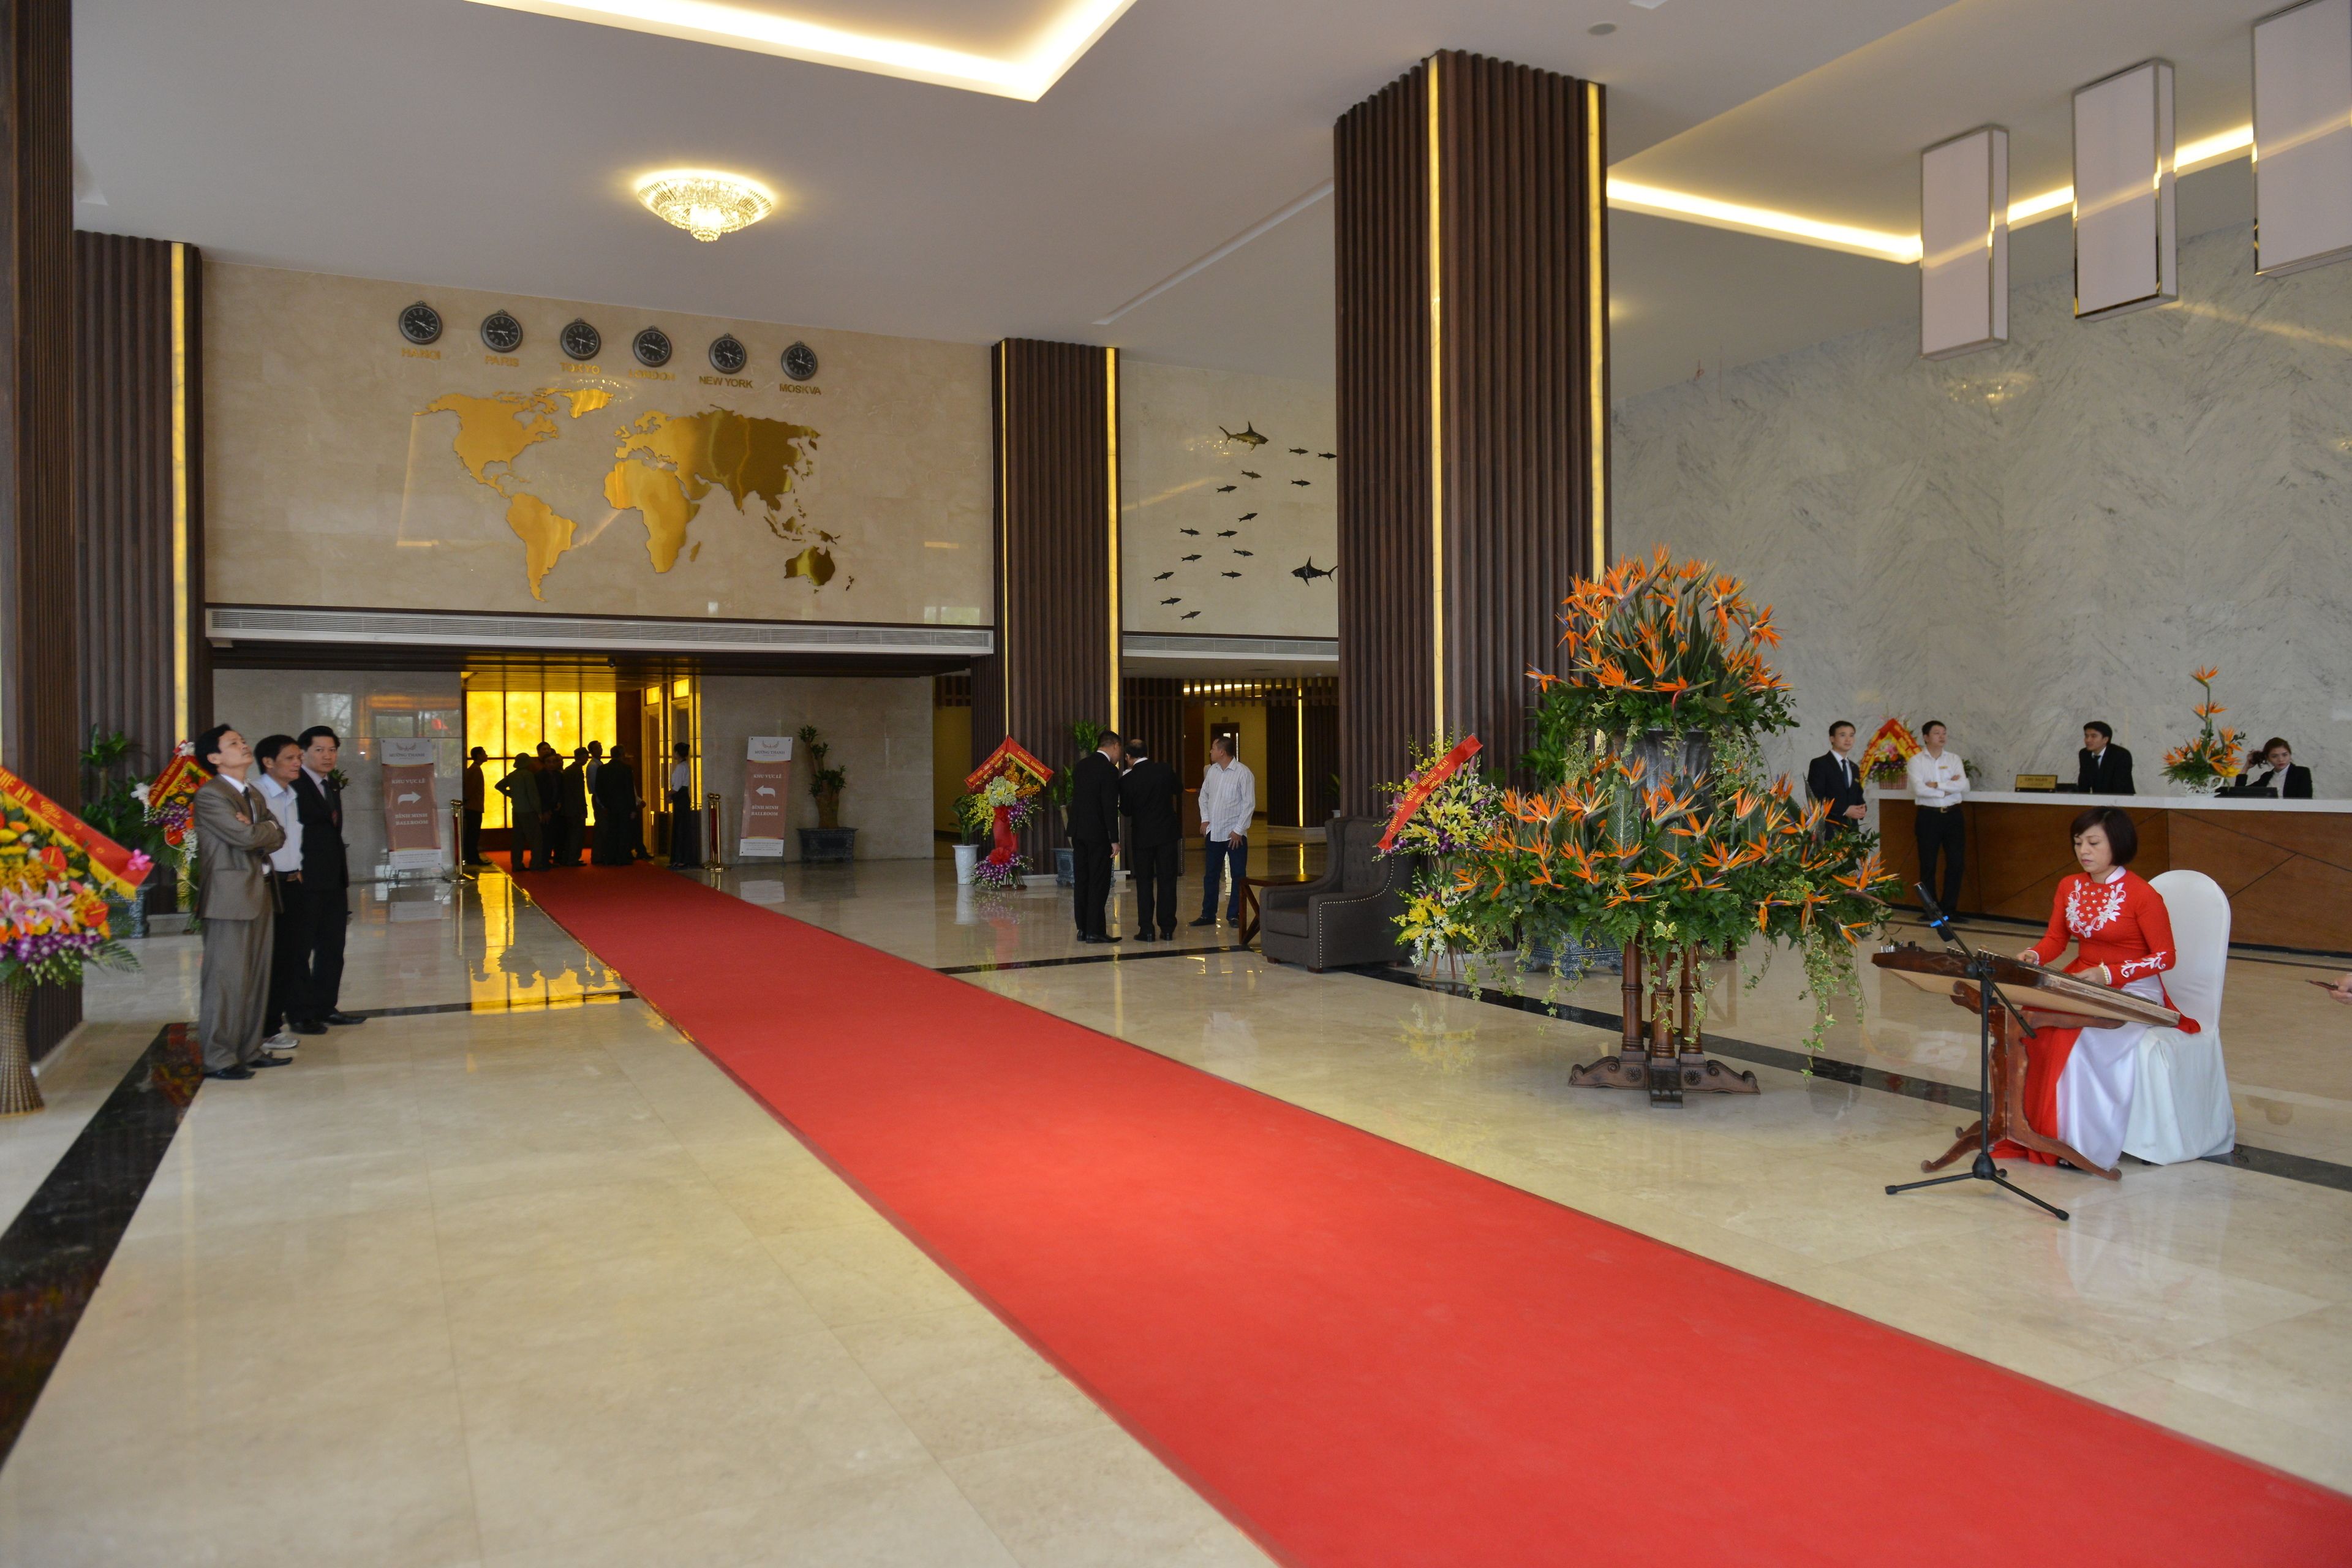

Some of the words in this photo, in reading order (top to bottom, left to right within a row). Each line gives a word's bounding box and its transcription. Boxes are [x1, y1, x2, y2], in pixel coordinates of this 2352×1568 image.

[401, 348, 441, 360] HANOI
[484, 355, 520, 368] PARIS
[560, 362, 601, 375] TOKYO
[628, 369, 675, 381] LONDON
[699, 375, 723, 386] NEW
[724, 378, 753, 388] YORK
[780, 383, 821, 395] MOSKVA
[1389, 816, 1399, 832] CÔNG
[1398, 804, 1406, 813] AN
[1406, 786, 1420, 802] QUẬN
[1437, 759, 1449, 771] MAI
